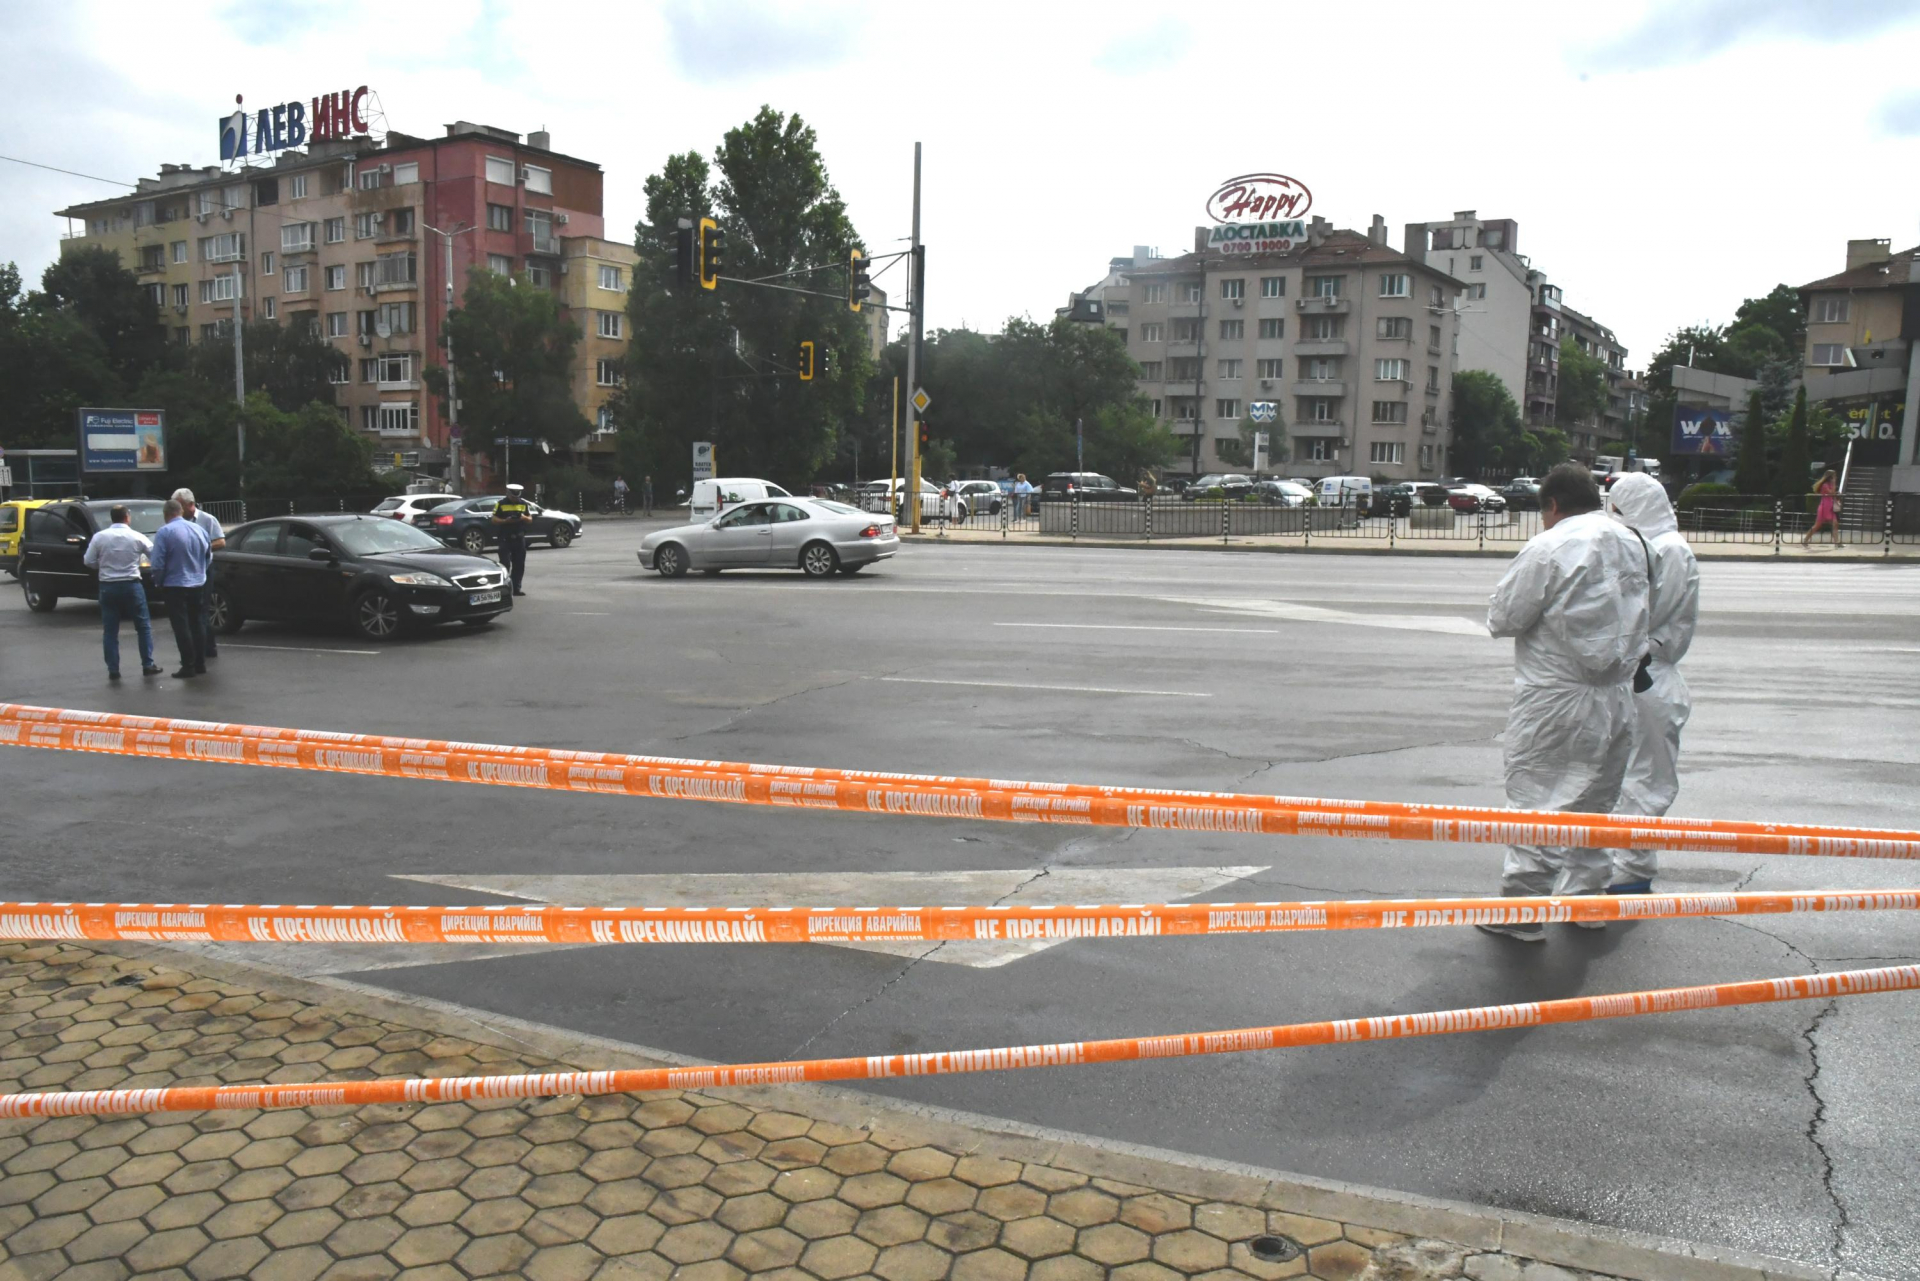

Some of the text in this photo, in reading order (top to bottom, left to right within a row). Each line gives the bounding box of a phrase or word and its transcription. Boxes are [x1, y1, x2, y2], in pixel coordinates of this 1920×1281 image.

[255, 85, 368, 154] ЛЕВ ИНС
[1219, 186, 1302, 220] Happy
[1211, 222, 1304, 242] ДОСТАВКА
[1222, 240, 1290, 253] 0700 19000
[1849, 408, 1891, 419] eft
[1680, 420, 1731, 435] WW
[1127, 805, 1147, 827] НЕ
[1208, 907, 1327, 929] ДИРЕКЦИЯ АВАРИЙНА
[1618, 899, 1676, 918] ДИРЕКЦИЯ
[115, 910, 206, 929] ДИРЕКЦИЯ АВАРИЙНА
[248, 912, 410, 942] НЕ ПРЕМИНАВАЙ!
[441, 913, 543, 933] ДИРЕКЦИЯ АВАРИЙНА
[591, 914, 768, 943] НЕ ПРЕМИНАВАЙ!
[808, 913, 921, 934] ДИРЕКЦИЯ АВАРИЙНА
[974, 910, 1163, 940] НЕ ПРЕМИНАВАЙ!
[1137, 1038, 1185, 1059] ПОМОЩ
[1190, 1036, 1199, 1054] И
[668, 1071, 715, 1089] ПОМОЩ
[720, 1070, 729, 1086] И
